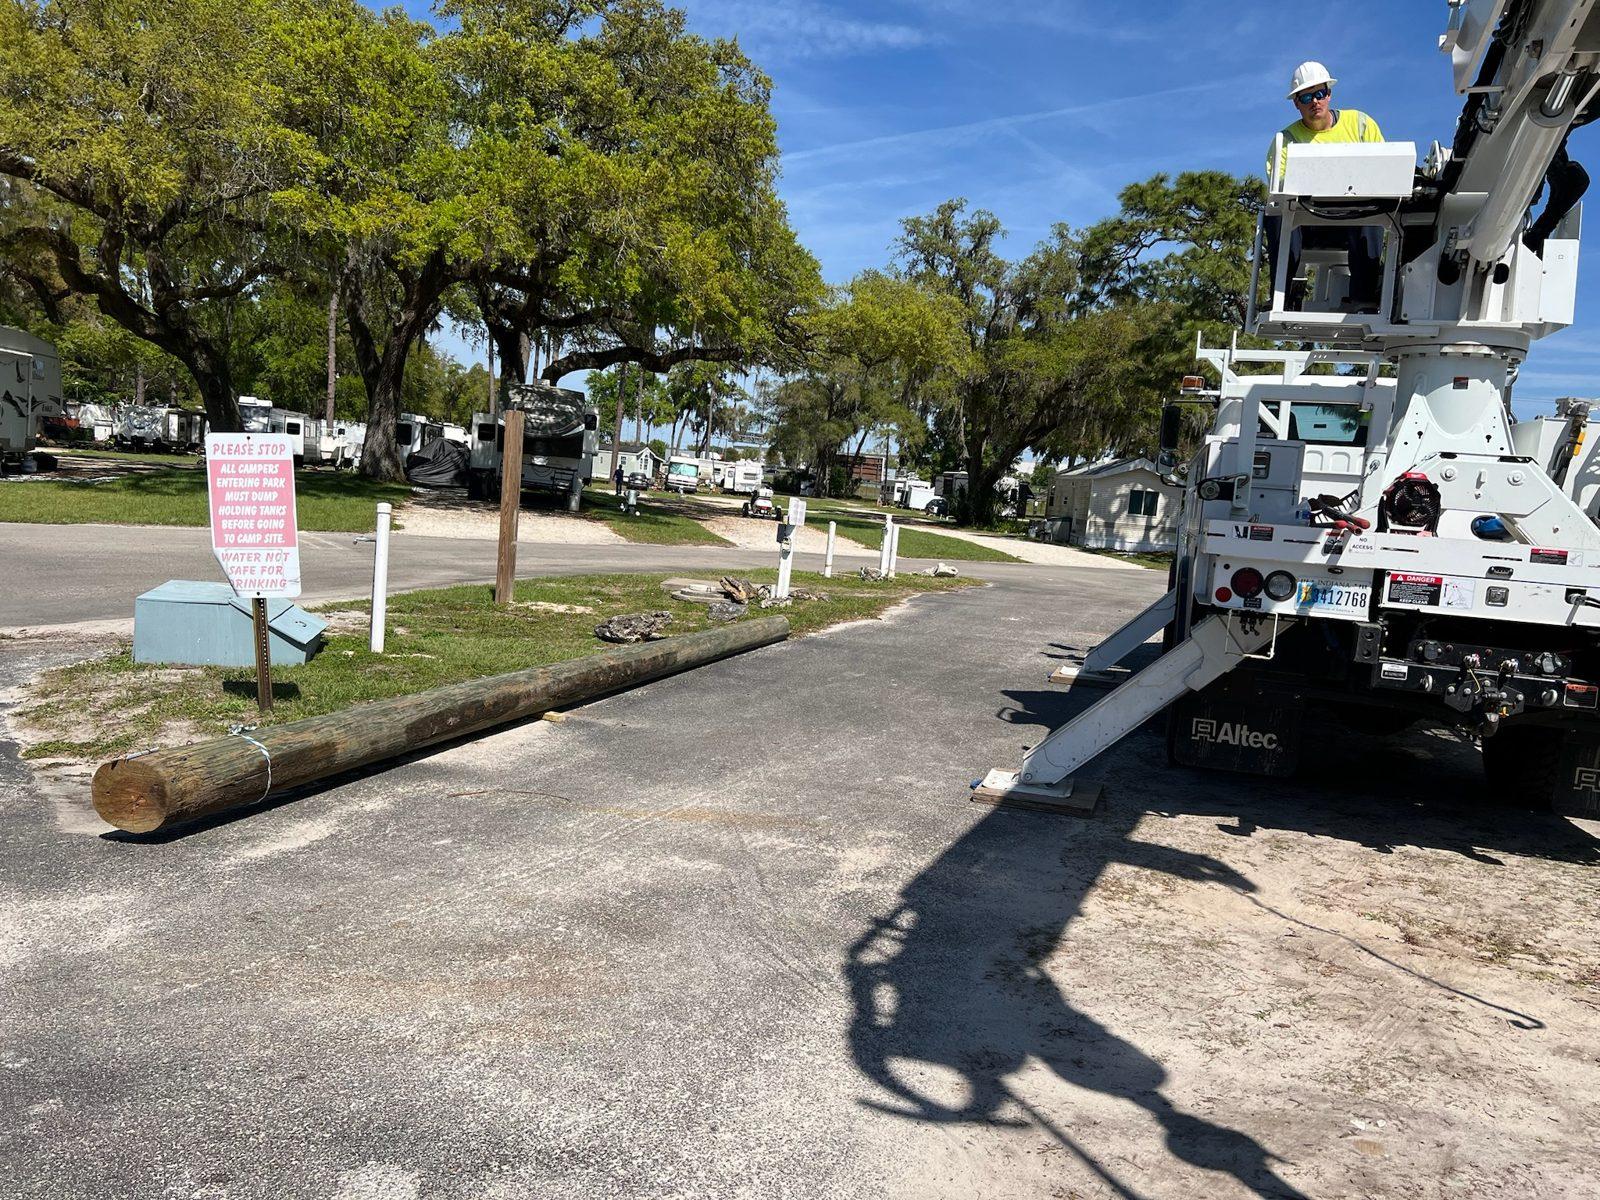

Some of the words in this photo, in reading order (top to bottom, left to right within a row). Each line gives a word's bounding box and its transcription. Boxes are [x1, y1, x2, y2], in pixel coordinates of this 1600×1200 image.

[213, 443, 254, 455] PLEASE
[258, 444, 286, 455] STOP
[220, 463, 236, 474] ALL
[238, 463, 279, 474] CAMPERS
[216, 477, 260, 488] ENTERING
[262, 478, 286, 488] PARK
[225, 491, 250, 502] MUST
[251, 491, 278, 501] DUMP
[218, 505, 257, 516] HOLDING
[259, 505, 287, 516] TANKS
[221, 519, 255, 530] BEFORE
[257, 519, 285, 530] GOING
[224, 533, 235, 544] TO
[237, 533, 262, 544] CAMP
[263, 533, 286, 544] SITE.
[221, 552, 261, 562] WATER
[265, 552, 290, 562] NOT
[228, 566, 257, 575] SAFE
[260, 566, 284, 575] FOR
[1317, 580, 1350, 588] INDIANA
[1406, 575, 1436, 583] DANGER
[1312, 587, 1368, 608] 3412768
[1216, 722, 1278, 749] Altec
